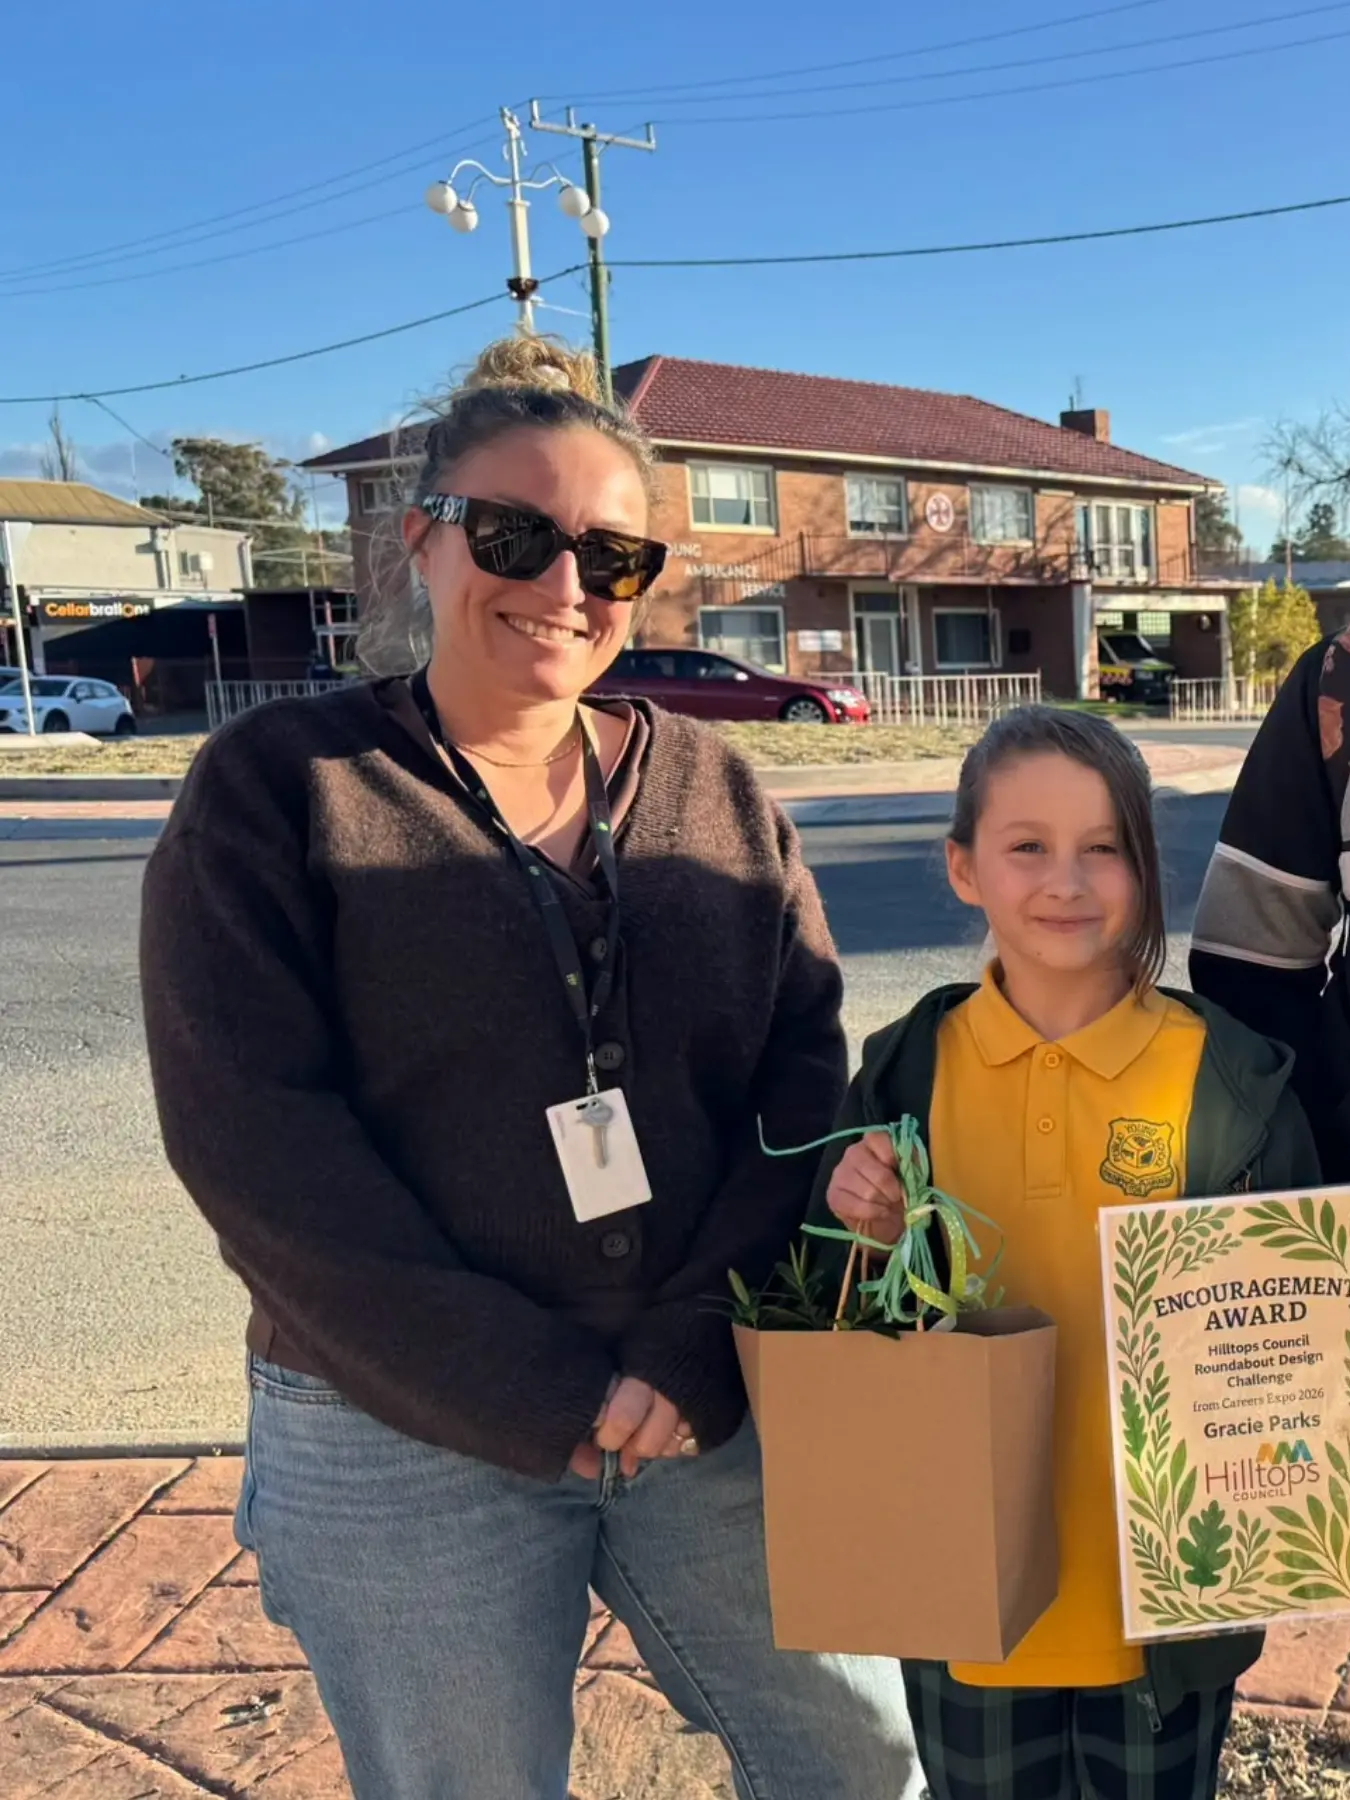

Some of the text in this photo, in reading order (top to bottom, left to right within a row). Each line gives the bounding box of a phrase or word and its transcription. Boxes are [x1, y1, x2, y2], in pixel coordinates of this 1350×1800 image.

[665, 543, 702, 558] OUNG
[684, 563, 760, 578] AMBULANCE
[741, 582, 786, 598] SERVICE
[1204, 1301, 1307, 1331] AWARD
[1208, 1334, 1310, 1357] Hilltops Council
[1194, 1351, 1324, 1375] Roundabout Design
[1227, 1372, 1293, 1388] Challenge
[1193, 1388, 1325, 1412] from Careers Expo 2026
[1204, 1411, 1321, 1439] Gracie Parks
[1205, 1458, 1320, 1496] Hilltops
[1233, 1488, 1287, 1502] COUNCIL
